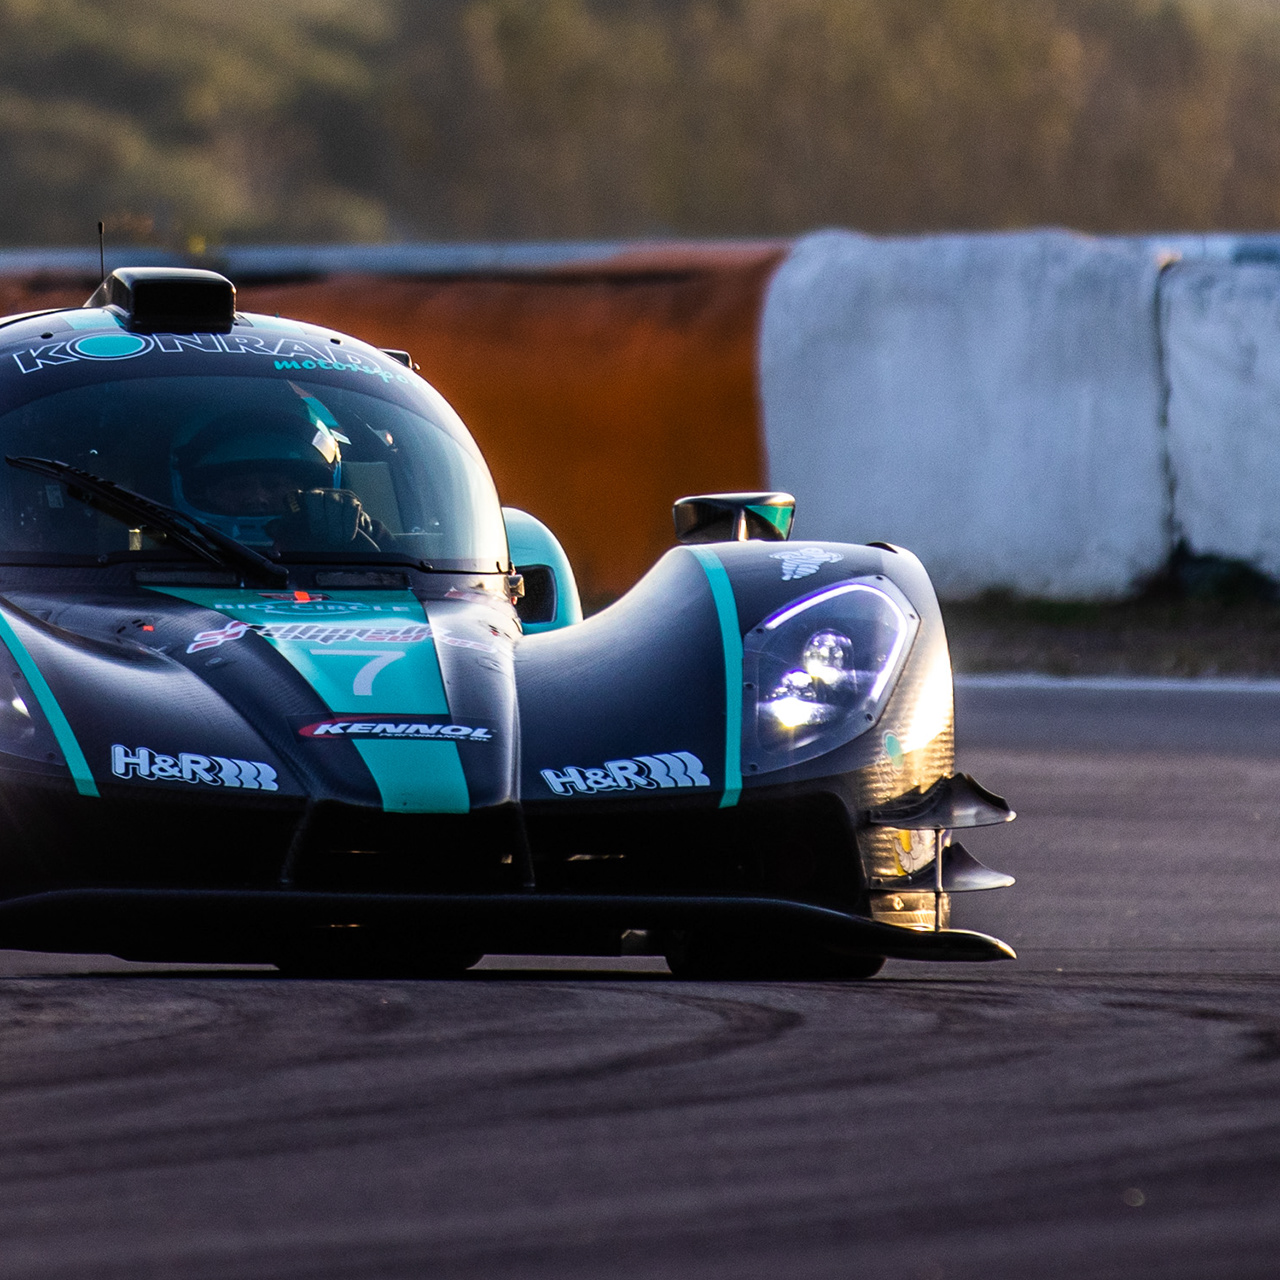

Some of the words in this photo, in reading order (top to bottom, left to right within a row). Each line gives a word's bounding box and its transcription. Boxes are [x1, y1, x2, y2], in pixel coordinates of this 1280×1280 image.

[13, 333, 381, 374] KONRAD
[214, 604, 410, 612] BIO-CIRCLE
[310, 649, 407, 696] 7
[313, 722, 493, 739] KENNOL
[111, 744, 222, 786] H&R
[540, 760, 657, 796] H&R
